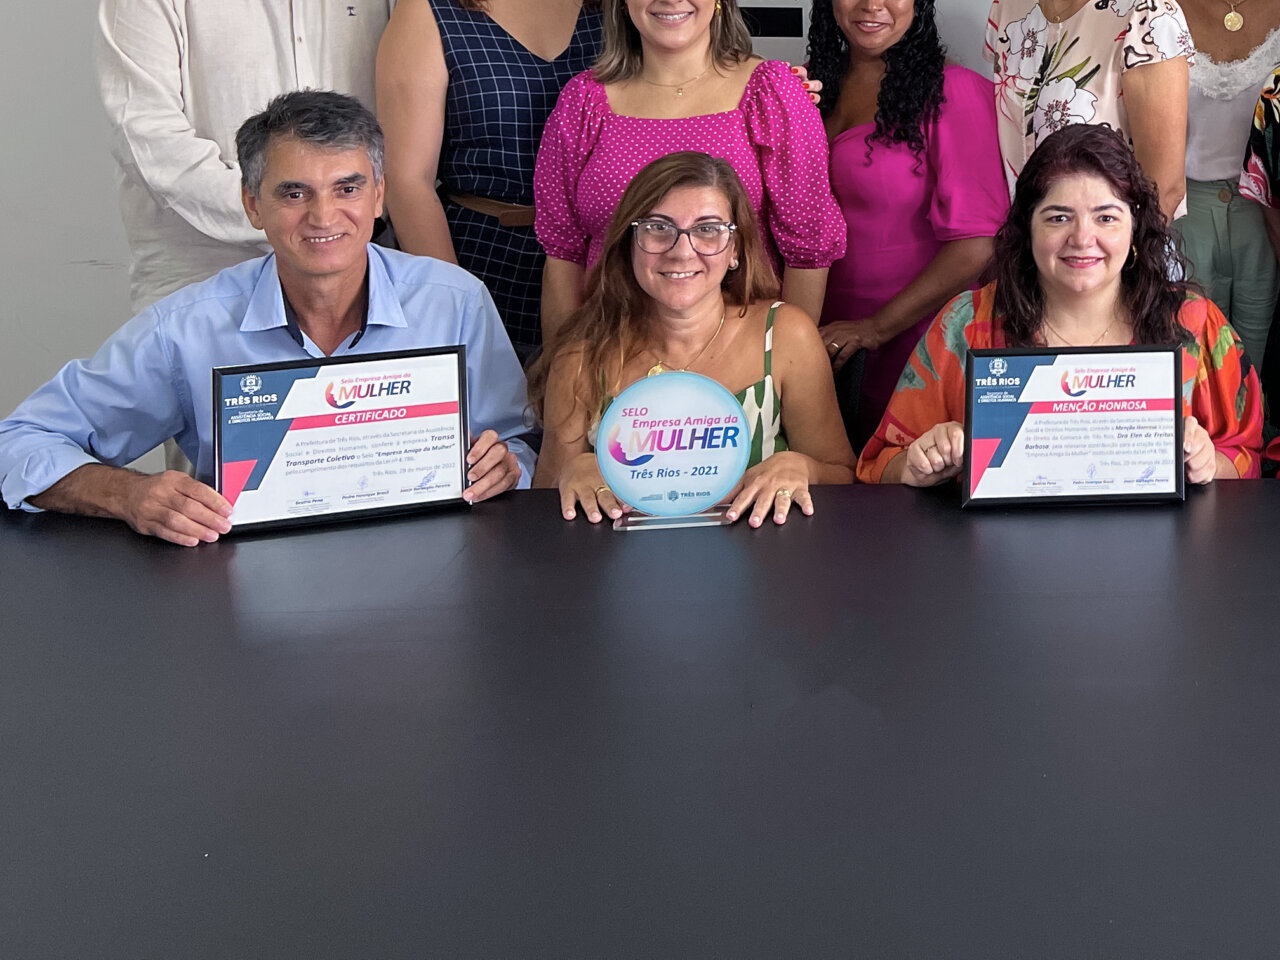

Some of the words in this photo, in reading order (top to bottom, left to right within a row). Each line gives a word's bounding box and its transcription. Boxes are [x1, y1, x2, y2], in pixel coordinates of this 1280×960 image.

[976, 376, 997, 386] TRÊS
[998, 377, 1020, 385] RIOS
[1072, 374, 1136, 389] MULHER
[338, 380, 411, 401] MULHER
[224, 395, 251, 406] TRÊS
[252, 393, 277, 404] RIOS
[1053, 401, 1097, 413] MENÇÃO
[1098, 401, 1147, 411] HONROSA
[334, 408, 407, 424] CERTIFICADO
[622, 407, 649, 417] SELO
[632, 418, 681, 430] Empresa
[684, 416, 720, 428] Amiga
[724, 415, 738, 424] da
[629, 426, 740, 452] MULHER
[286, 458, 325, 467] Transporte
[326, 454, 356, 463] Coletivo
[630, 468, 653, 480] Três
[656, 467, 680, 478] Rios
[691, 465, 719, 477] 2021
